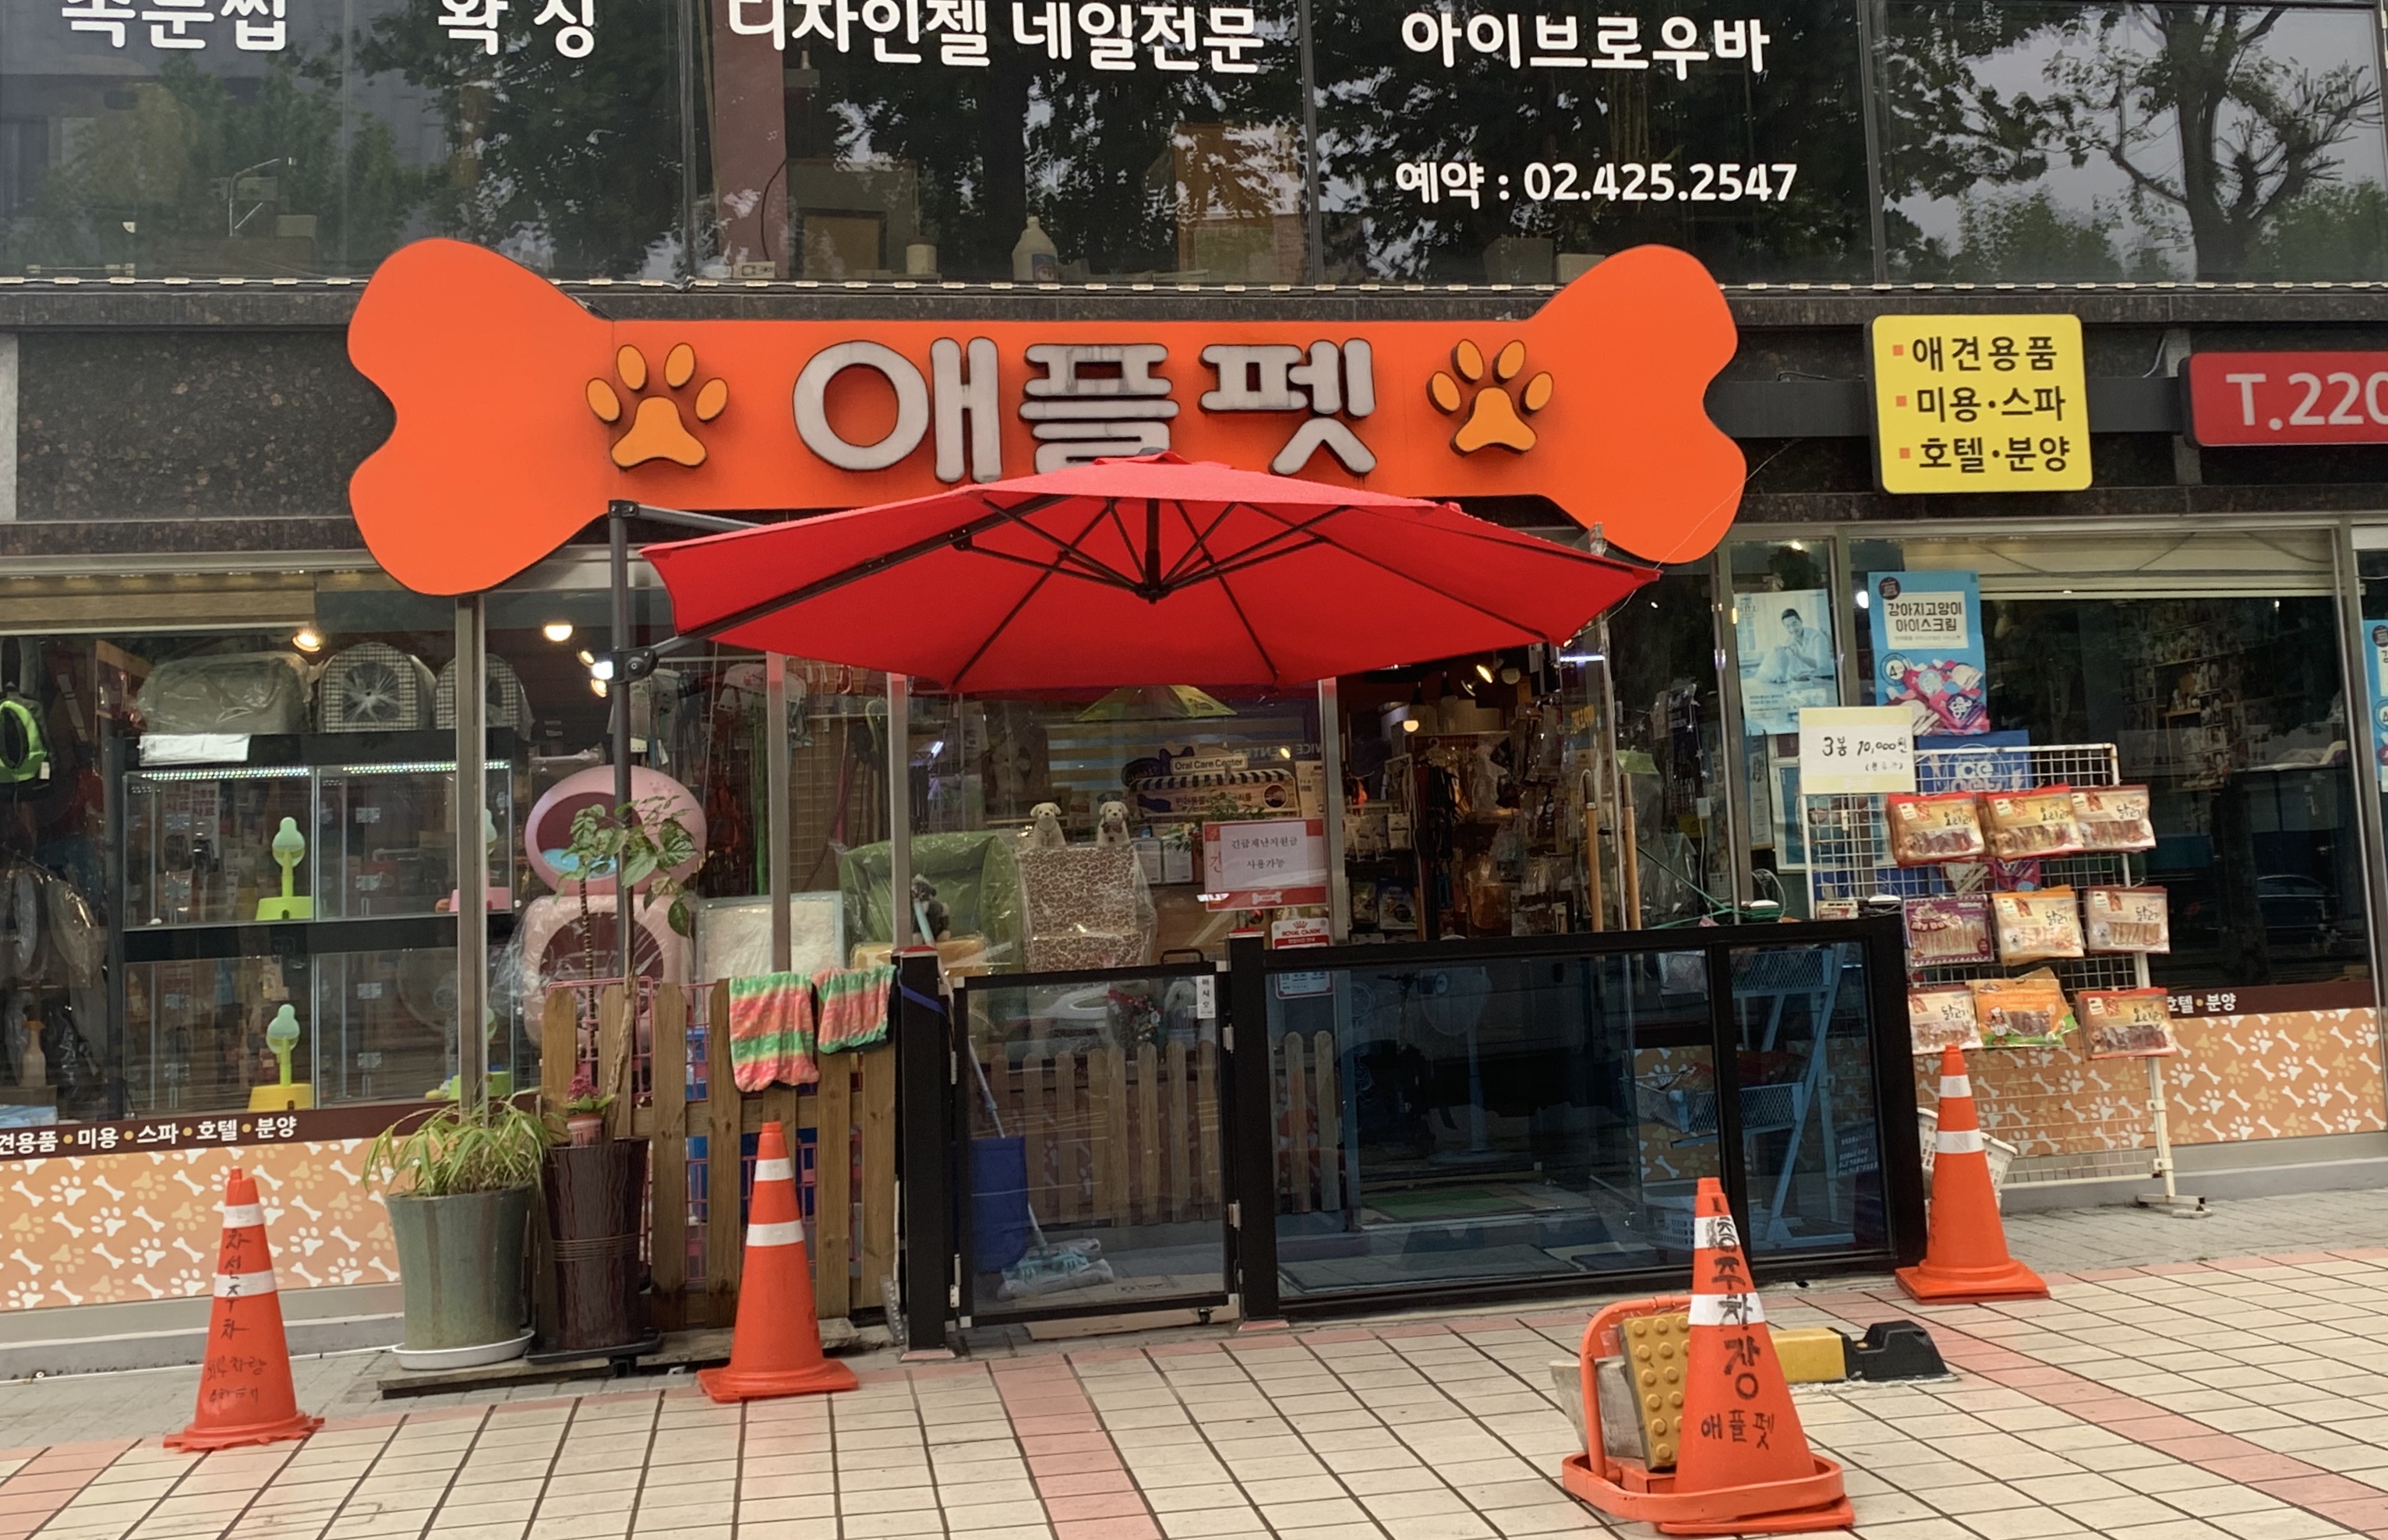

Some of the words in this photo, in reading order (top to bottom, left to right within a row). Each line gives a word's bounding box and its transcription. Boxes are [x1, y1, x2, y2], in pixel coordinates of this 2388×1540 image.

[728, 0, 991, 67] 디자인젤
[1013, 2, 1265, 74] 네일전문
[1402, 12, 1771, 81] 아이브로우바
[1395, 161, 1485, 210] 예약
[1524, 161, 1798, 203] 02.425.2547
[1912, 335, 2058, 373] 애견용품
[792, 336, 1378, 484] 애플펫
[1895, 618, 1957, 632] 아이스크림
[1174, 760, 1192, 771] Oral
[1194, 758, 1213, 769] Care
[1822, 736, 1848, 757] 3봉
[1231, 836, 1298, 849] 긴급재난지원금
[1247, 858, 1285, 870] 사용가능
[2206, 992, 2237, 1012] 분양
[0, 1130, 58, 1155] 견용품
[77, 1127, 119, 1150] 미용
[136, 1123, 179, 1144] 스파
[196, 1119, 238, 1141] 호텔
[255, 1116, 297, 1139] 분양
[1701, 1408, 1775, 1451] 애플펫
